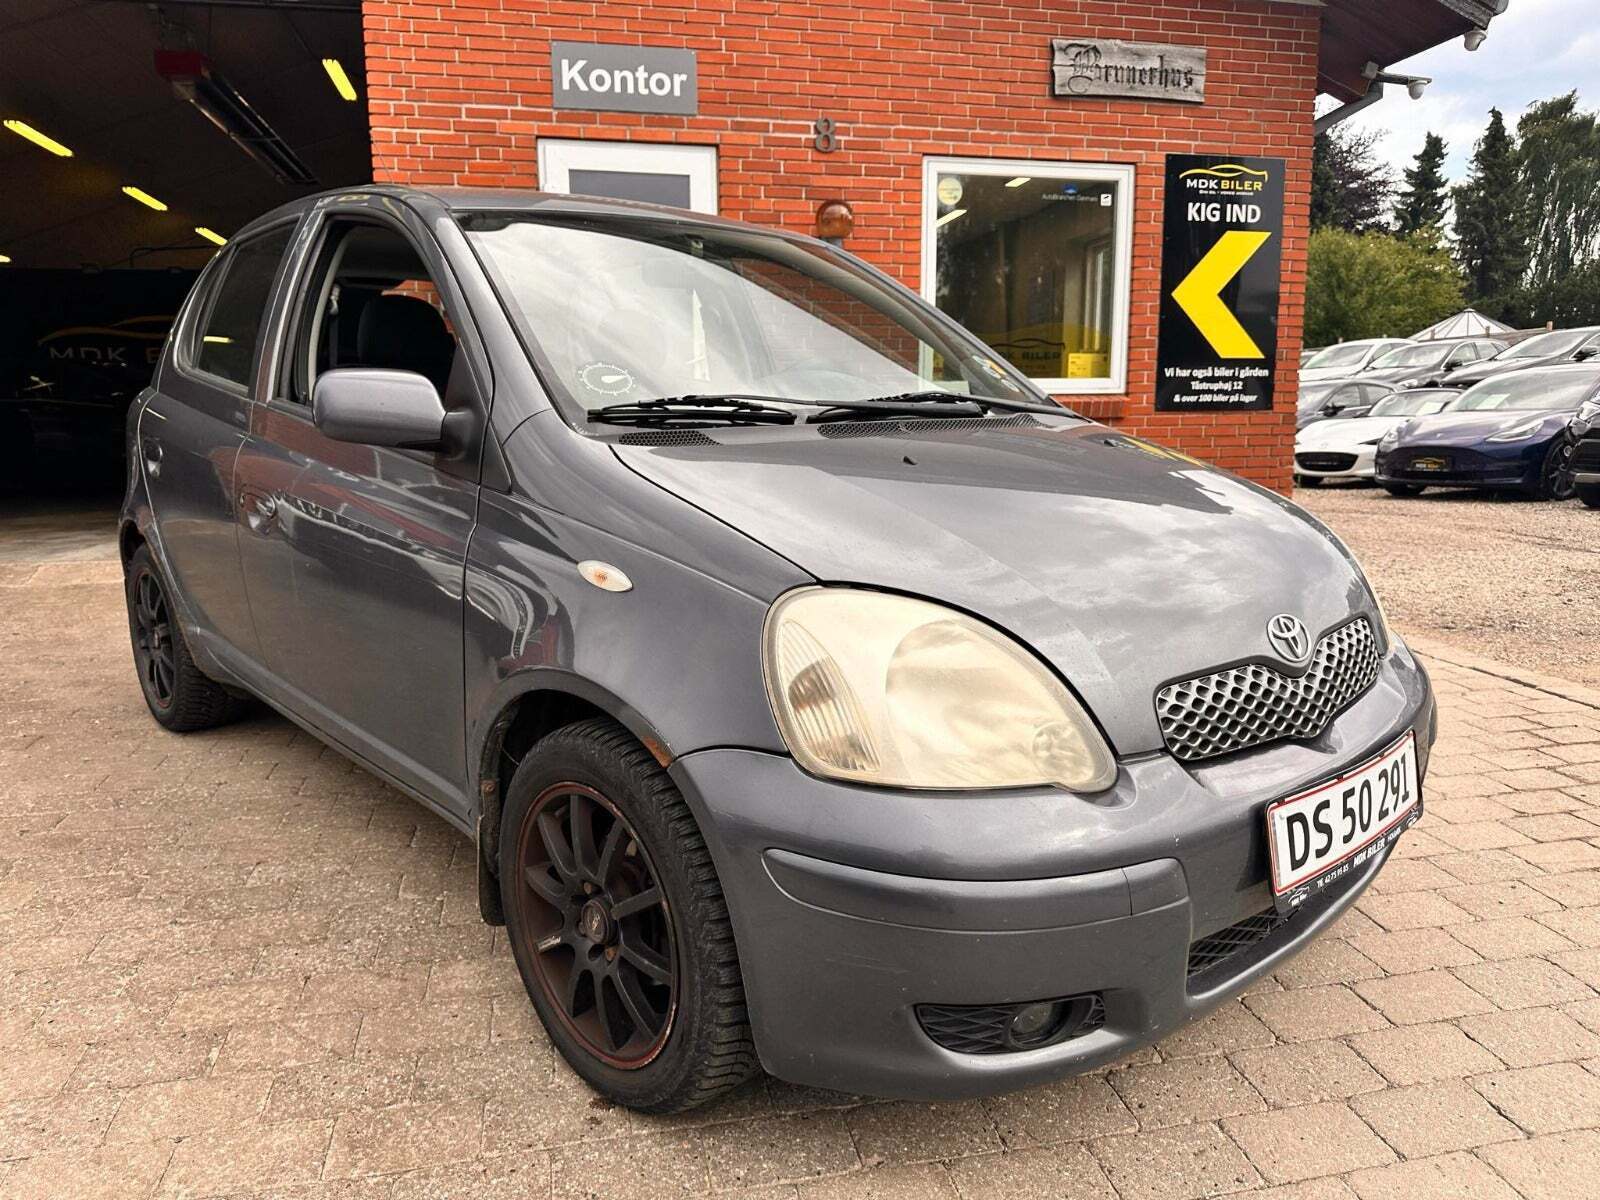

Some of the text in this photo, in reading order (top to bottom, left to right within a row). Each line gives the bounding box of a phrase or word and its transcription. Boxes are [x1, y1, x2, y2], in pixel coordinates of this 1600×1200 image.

[561, 58, 688, 97] Kontor
[815, 118, 836, 153] 8
[1186, 178, 1263, 191] MDK BILER
[1187, 202, 1261, 223] KIG IND
[1164, 367, 1174, 377] Vi
[1175, 367, 1191, 377] har
[1192, 366, 1212, 378] også
[1213, 367, 1234, 377] biler
[1239, 366, 1269, 378] gården
[1233, 381, 1244, 390] 12
[1212, 394, 1230, 402] biler
[1229, 393, 1239, 403] på
[1286, 752, 1410, 872] DS 50 291
